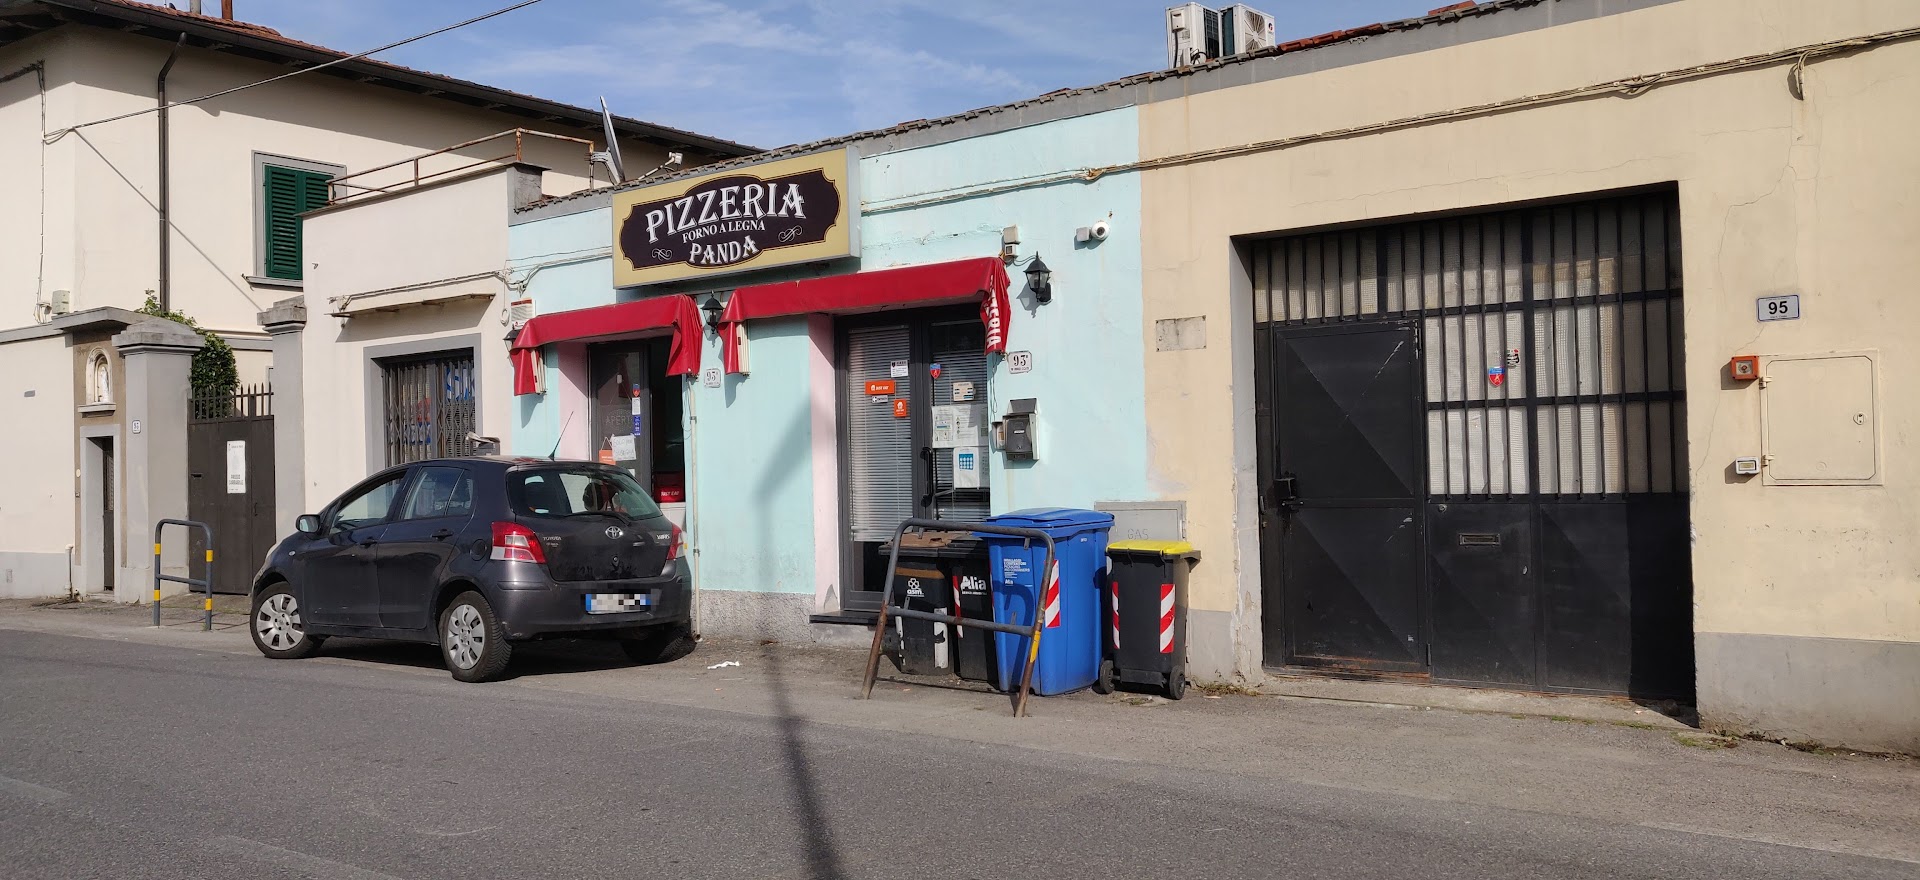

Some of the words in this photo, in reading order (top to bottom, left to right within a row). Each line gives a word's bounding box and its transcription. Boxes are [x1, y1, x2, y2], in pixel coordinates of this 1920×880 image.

[645, 182, 806, 244] PIZZERIA
[681, 225, 718, 244] FORNO
[719, 222, 727, 234] A
[728, 219, 766, 232] LEGNA
[689, 235, 760, 265] PANDA
[1768, 300, 1789, 315] 95
[1127, 528, 1149, 540] GAS
[961, 575, 987, 591] Alia
